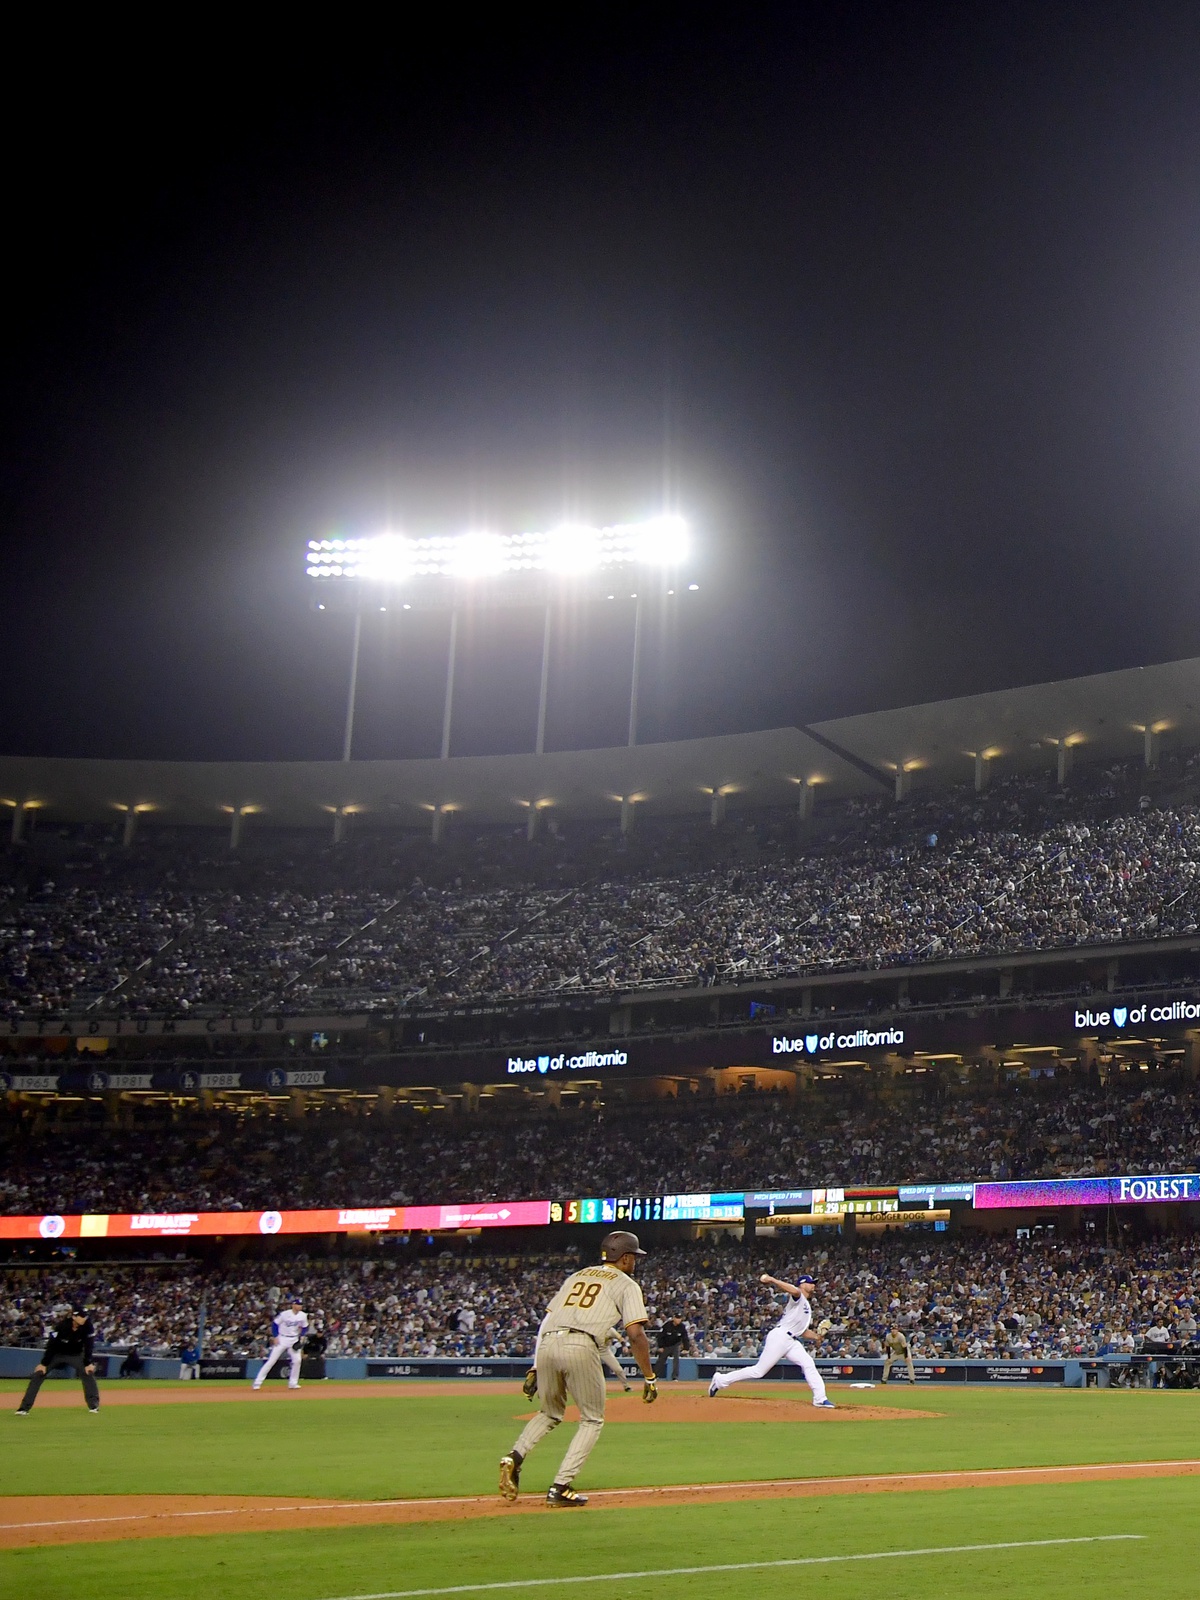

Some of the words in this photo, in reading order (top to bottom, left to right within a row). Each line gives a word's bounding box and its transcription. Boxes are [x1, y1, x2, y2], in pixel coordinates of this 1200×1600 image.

[1074, 1009, 1111, 1028] blue
[1129, 1004, 1147, 1023] of
[10, 1019, 176, 1035] STADIUM
[206, 1017, 285, 1032] CLUB
[772, 1036, 804, 1054] blue
[819, 1034, 836, 1051] of
[837, 1027, 904, 1049] california
[507, 1057, 536, 1074] blue
[549, 1054, 564, 1071] of
[568, 1050, 628, 1070] california
[20, 1078, 50, 1088] 1965
[116, 1076, 143, 1087] 1981
[206, 1075, 234, 1086] 1988
[293, 1072, 319, 1084] 2020
[1120, 1179, 1192, 1200] FOREST
[568, 1202, 577, 1222] 5
[587, 1201, 595, 1221] 3
[617, 1206, 624, 1220] 8
[633, 1205, 641, 1220] 0
[645, 1205, 651, 1220] 1
[653, 1204, 661, 1220] 2
[848, 1202, 854, 1213] 0
[866, 1202, 872, 1212] 0
[892, 1201, 898, 1211] 4
[870, 1213, 901, 1221] DODGER
[903, 1212, 926, 1220] DOGS
[563, 1282, 602, 1309] 28
[394, 1366, 411, 1375] MLB
[466, 1366, 483, 1375] MLB
